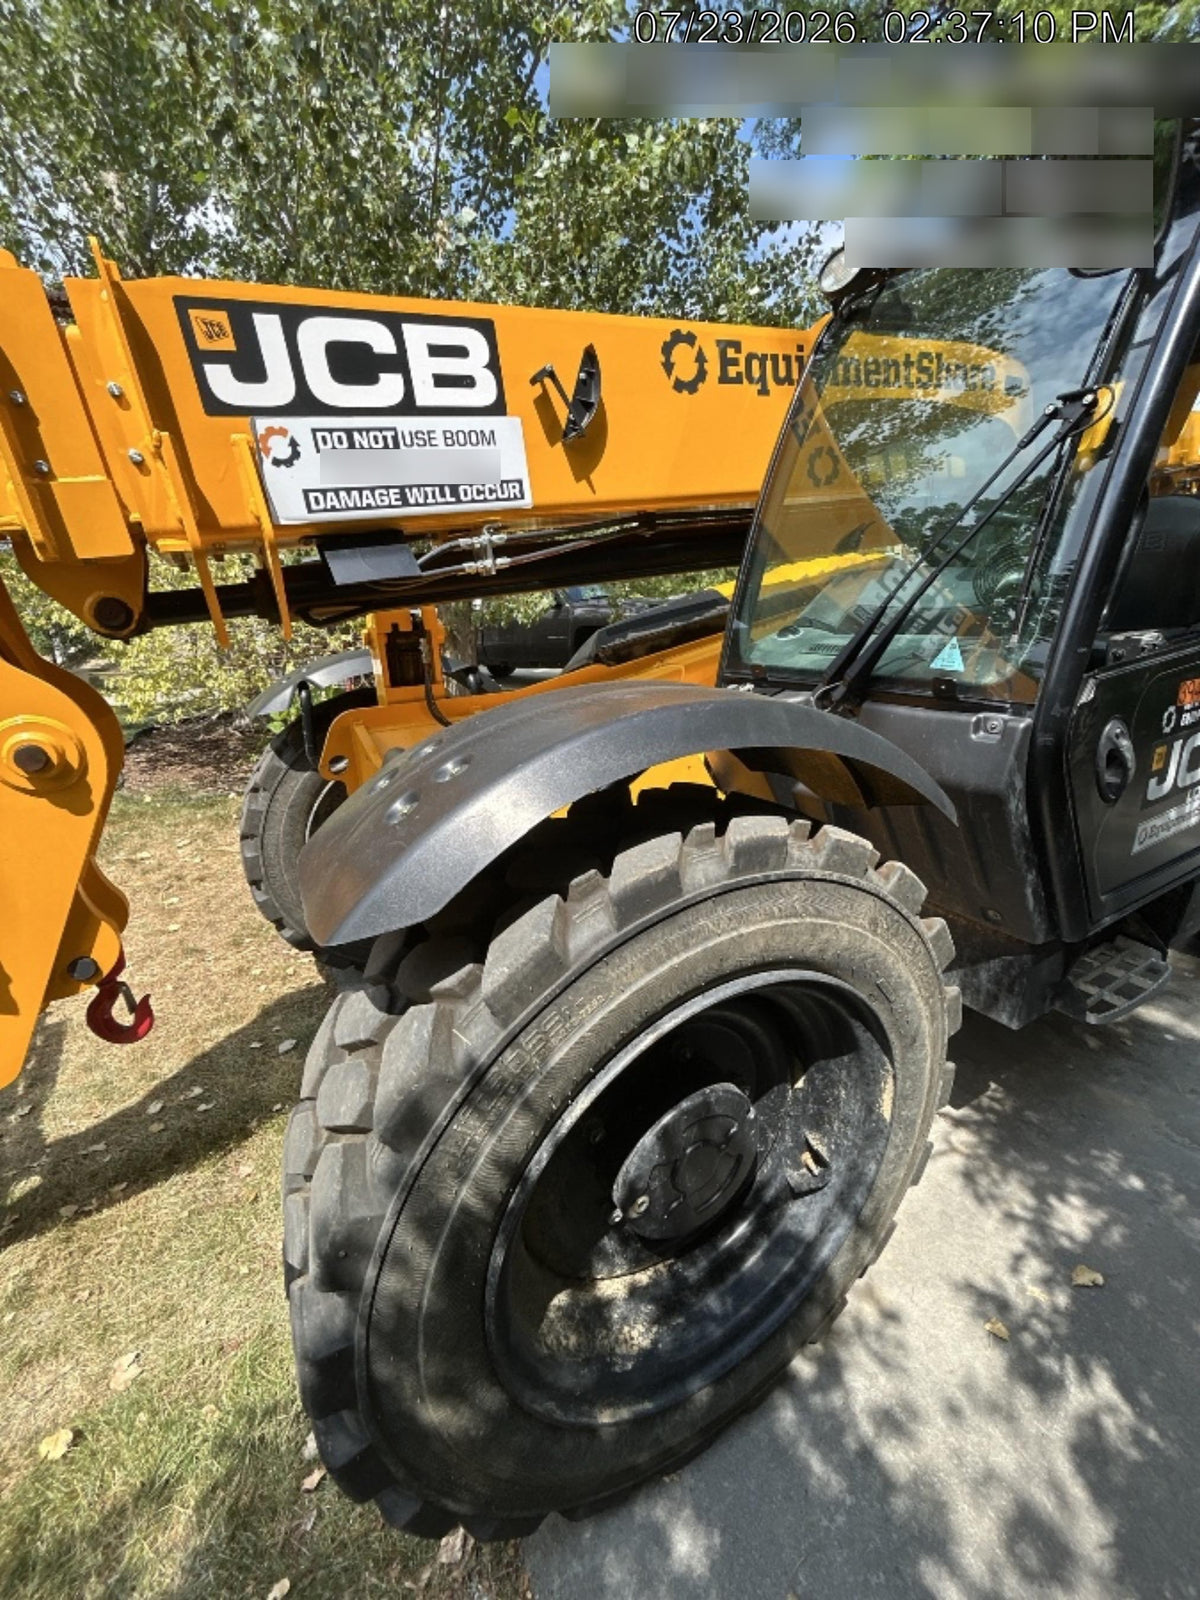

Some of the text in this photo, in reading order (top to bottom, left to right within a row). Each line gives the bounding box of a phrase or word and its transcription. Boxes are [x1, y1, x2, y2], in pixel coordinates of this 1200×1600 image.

[202, 312, 499, 408] JCB
[316, 429, 497, 449] DO NOT USE BOOM
[308, 481, 522, 511] DAMAGE WILL OCCUR
